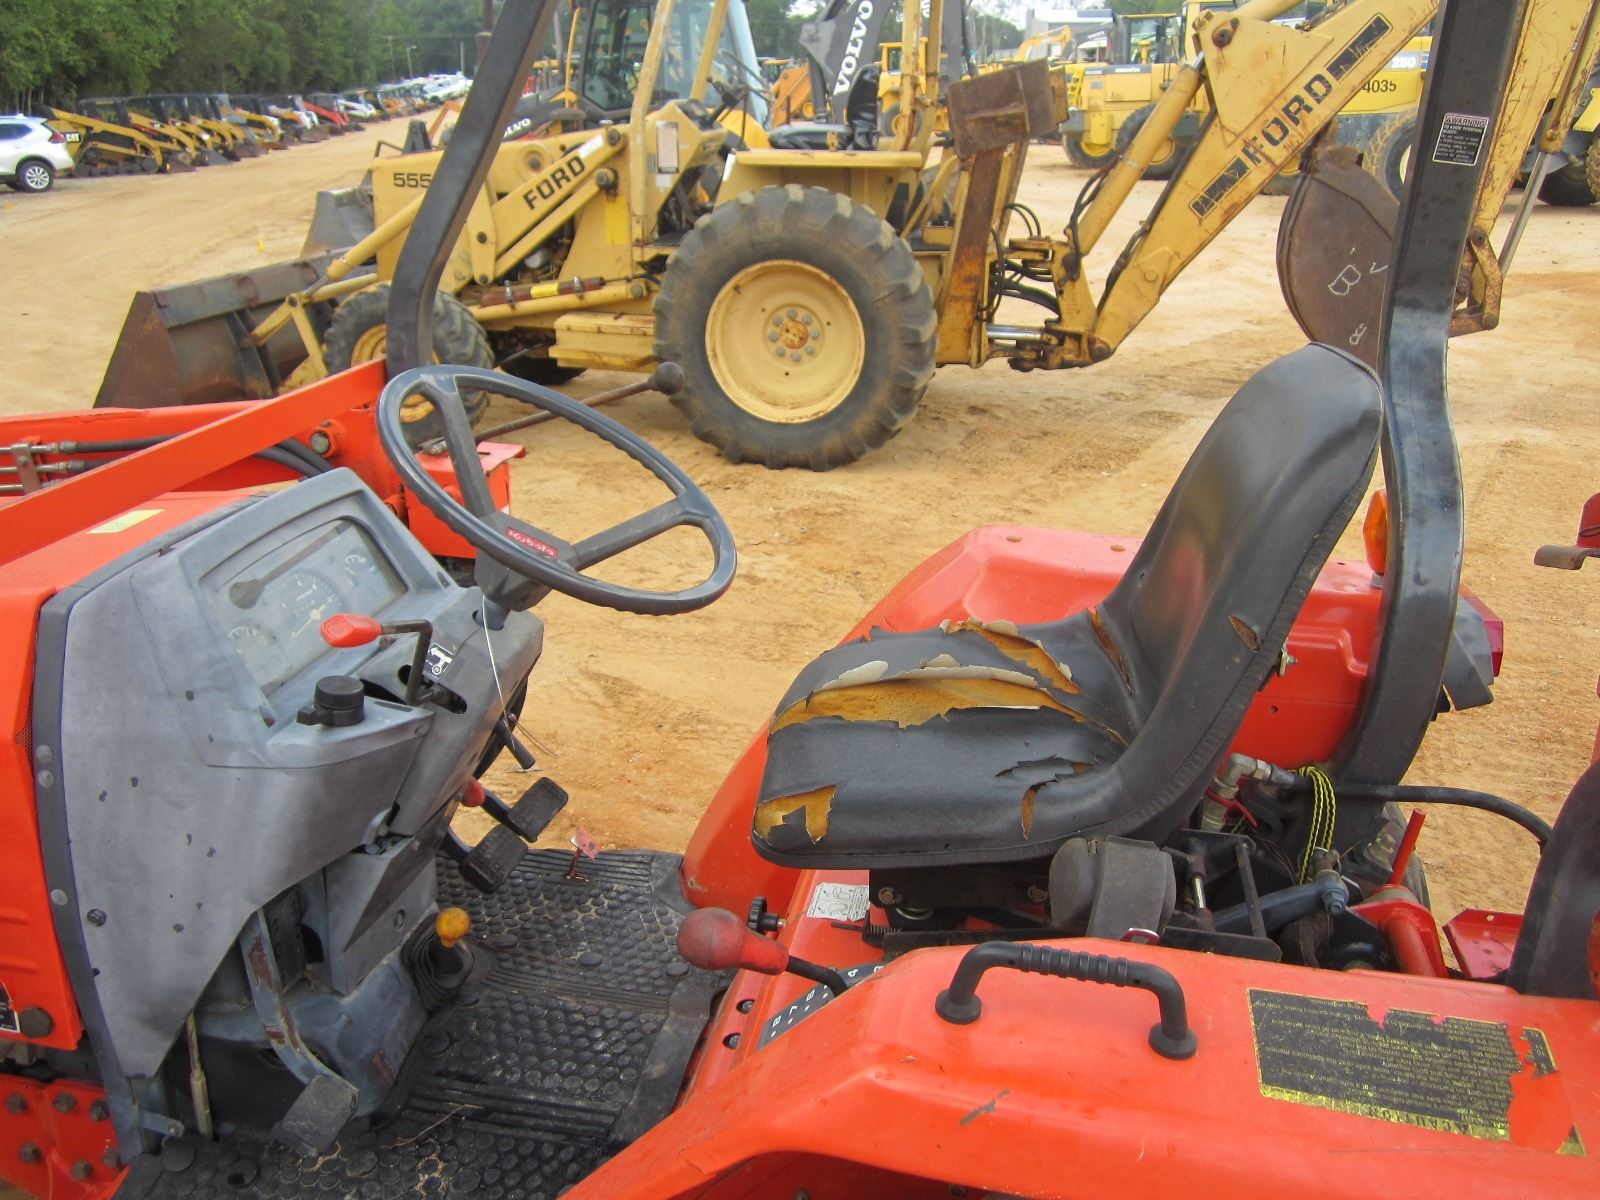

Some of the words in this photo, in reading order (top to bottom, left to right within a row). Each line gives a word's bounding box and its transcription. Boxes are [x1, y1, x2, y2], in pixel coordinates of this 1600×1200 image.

[833, 0, 873, 96] VOLVO
[1363, 79, 1397, 93] 4035
[1242, 73, 1333, 167] FORD
[1451, 117, 1487, 128] WARNING
[522, 156, 586, 210] FORD
[509, 530, 555, 556] Kubota
